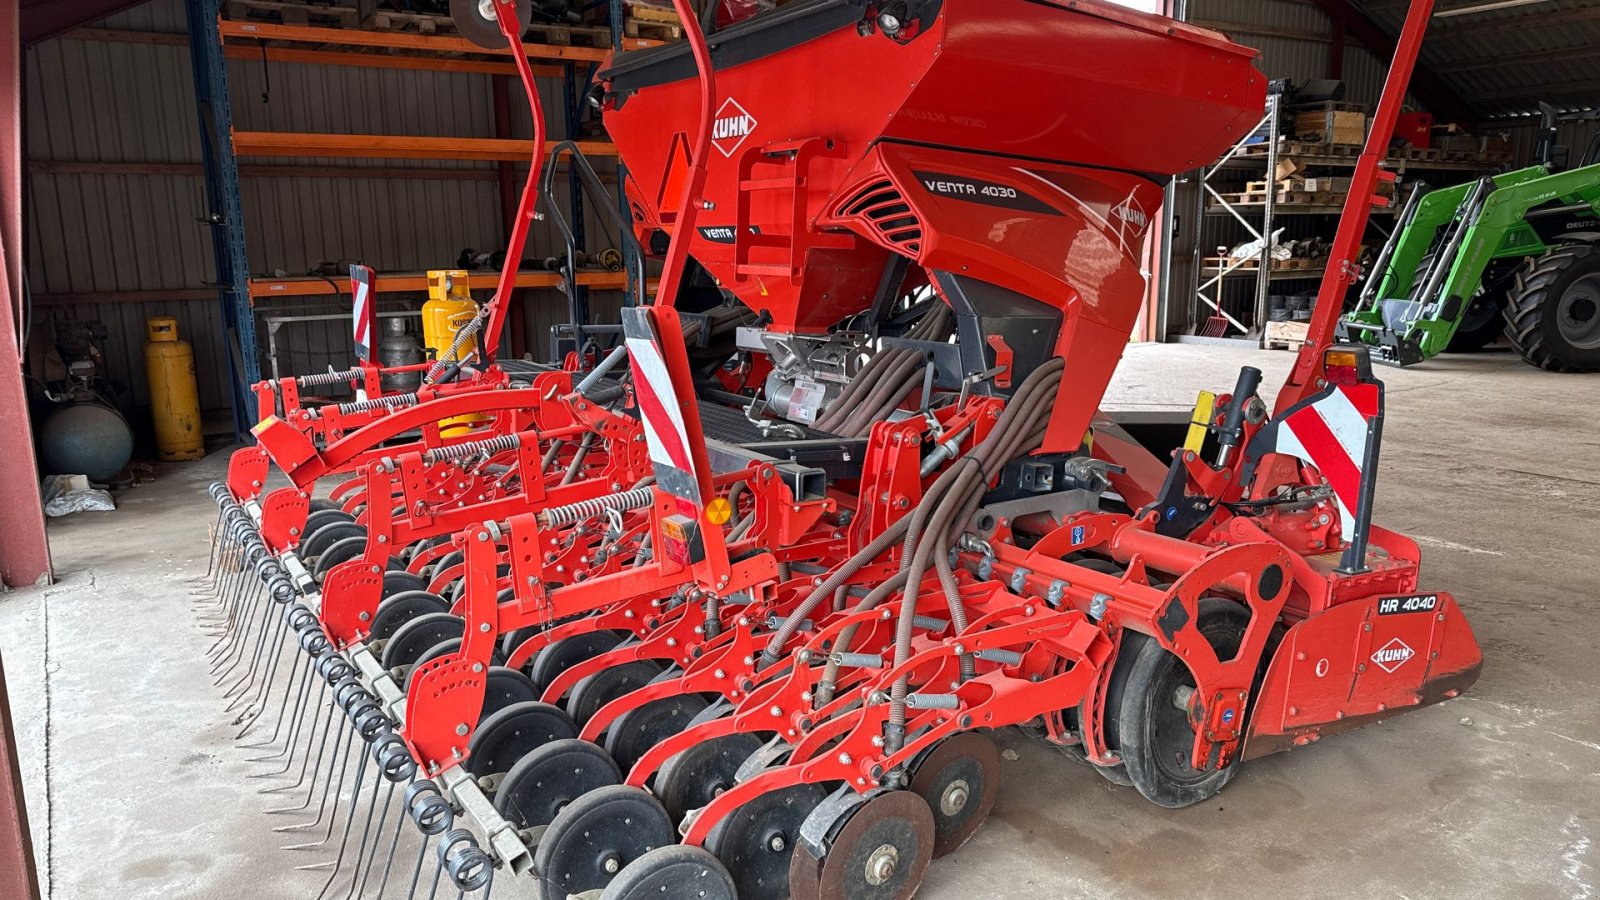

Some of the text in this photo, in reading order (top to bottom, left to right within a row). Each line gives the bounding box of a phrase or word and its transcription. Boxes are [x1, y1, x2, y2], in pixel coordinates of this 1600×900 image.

[925, 180, 1017, 198] VENTA 4030
[703, 228, 734, 239] VENTA
[1379, 596, 1437, 613] HR 4040
[1375, 648, 1411, 663] KUHN
